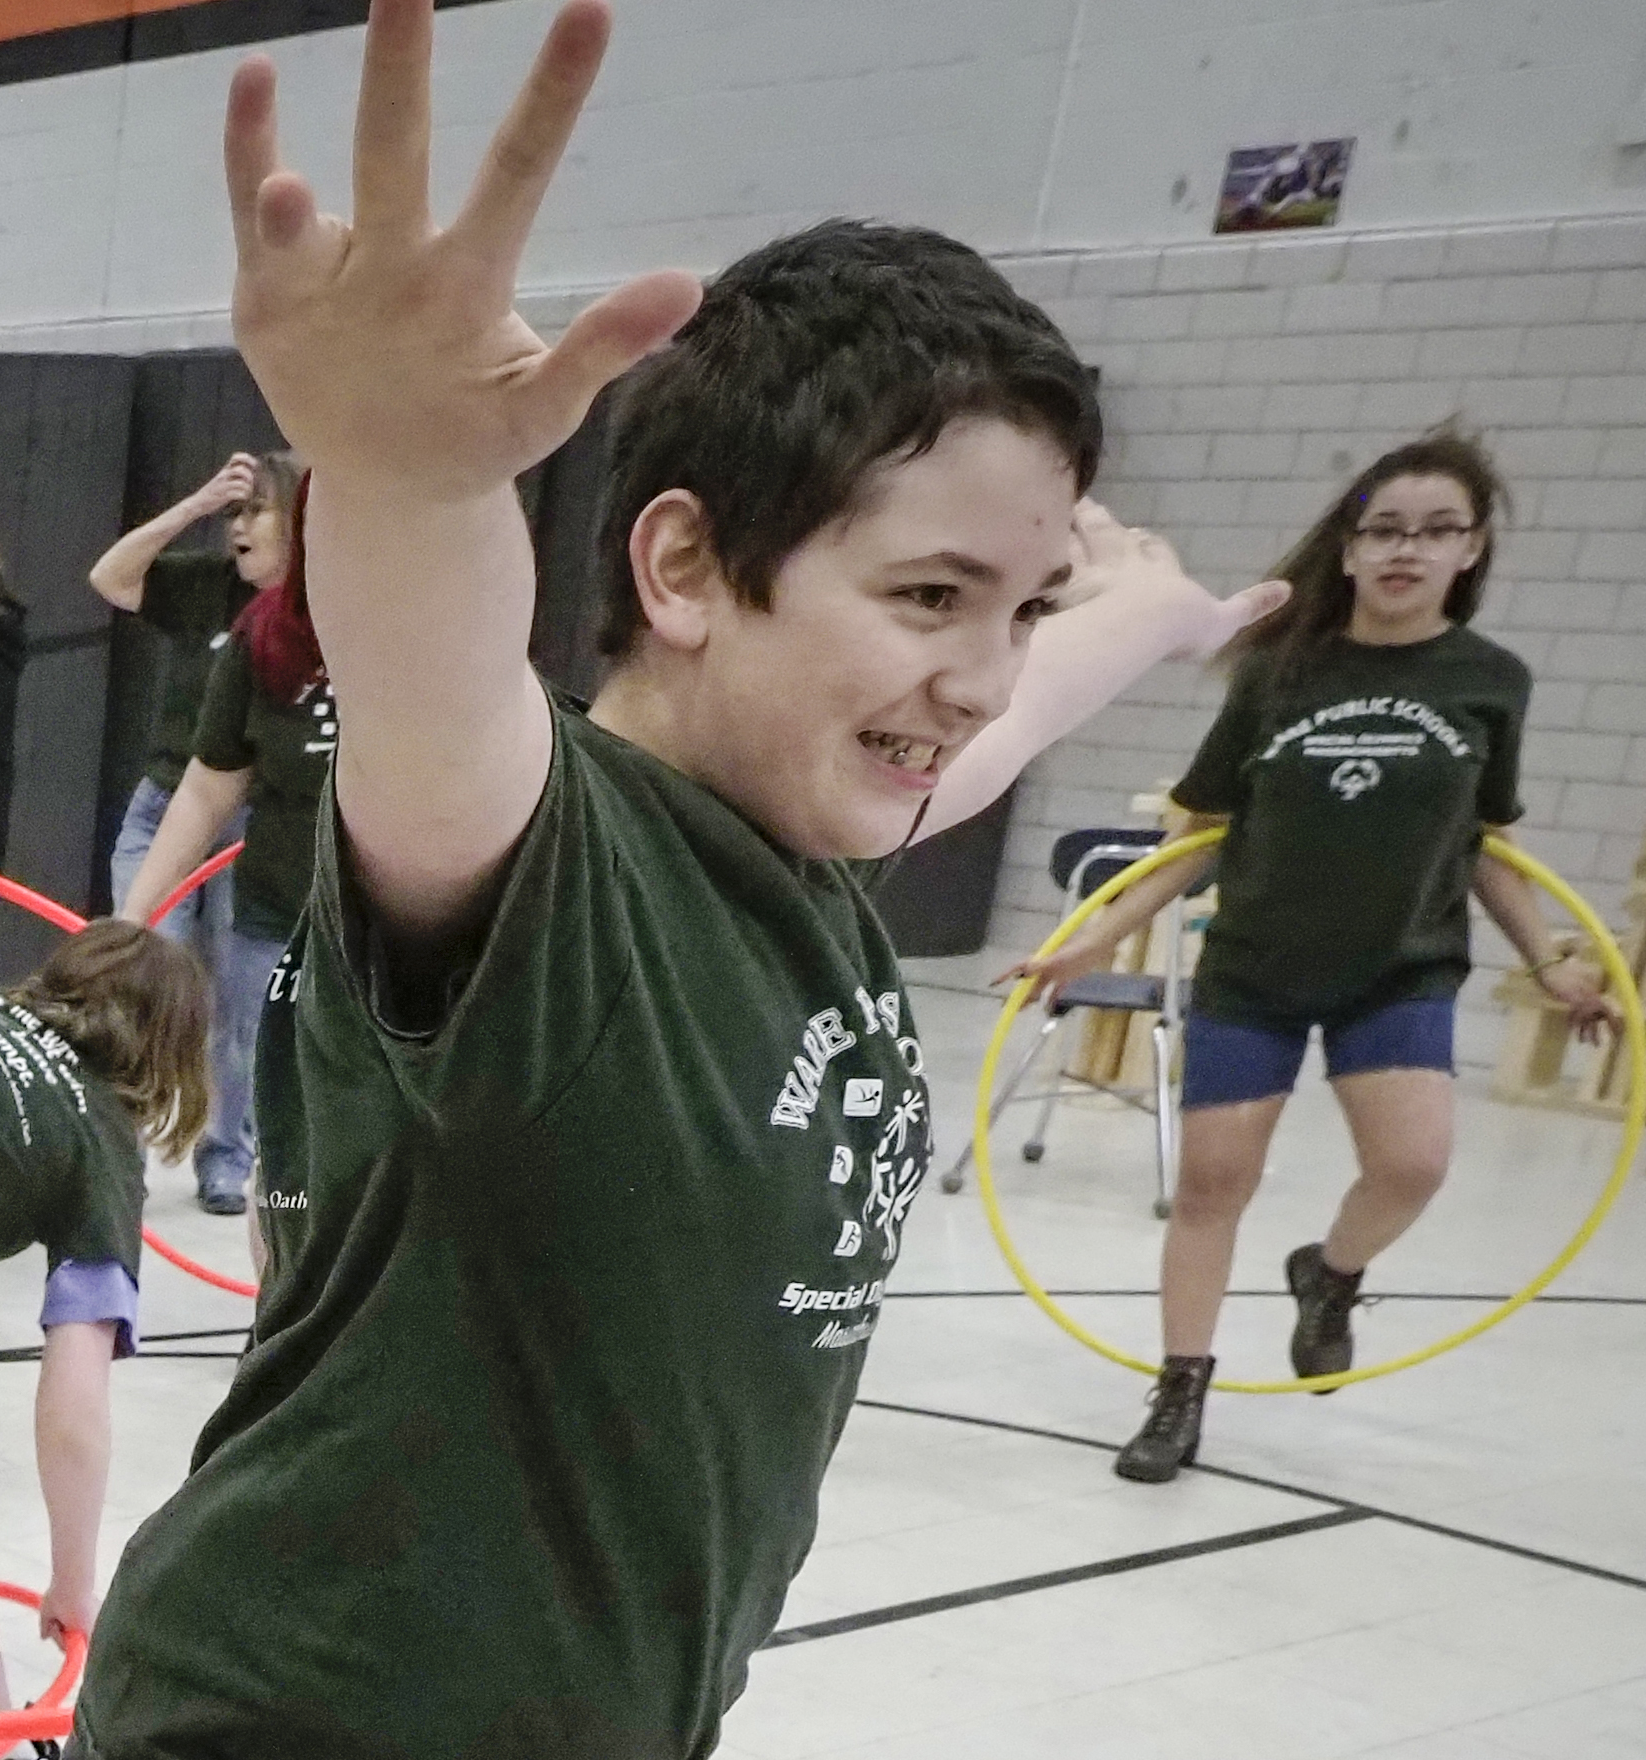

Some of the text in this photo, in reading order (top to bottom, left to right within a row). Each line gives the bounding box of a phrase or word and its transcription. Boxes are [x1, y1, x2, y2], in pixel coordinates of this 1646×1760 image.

[770, 1006, 858, 1131] WARE
[268, 1190, 309, 1210] Oath
[778, 1281, 869, 1316] Special
